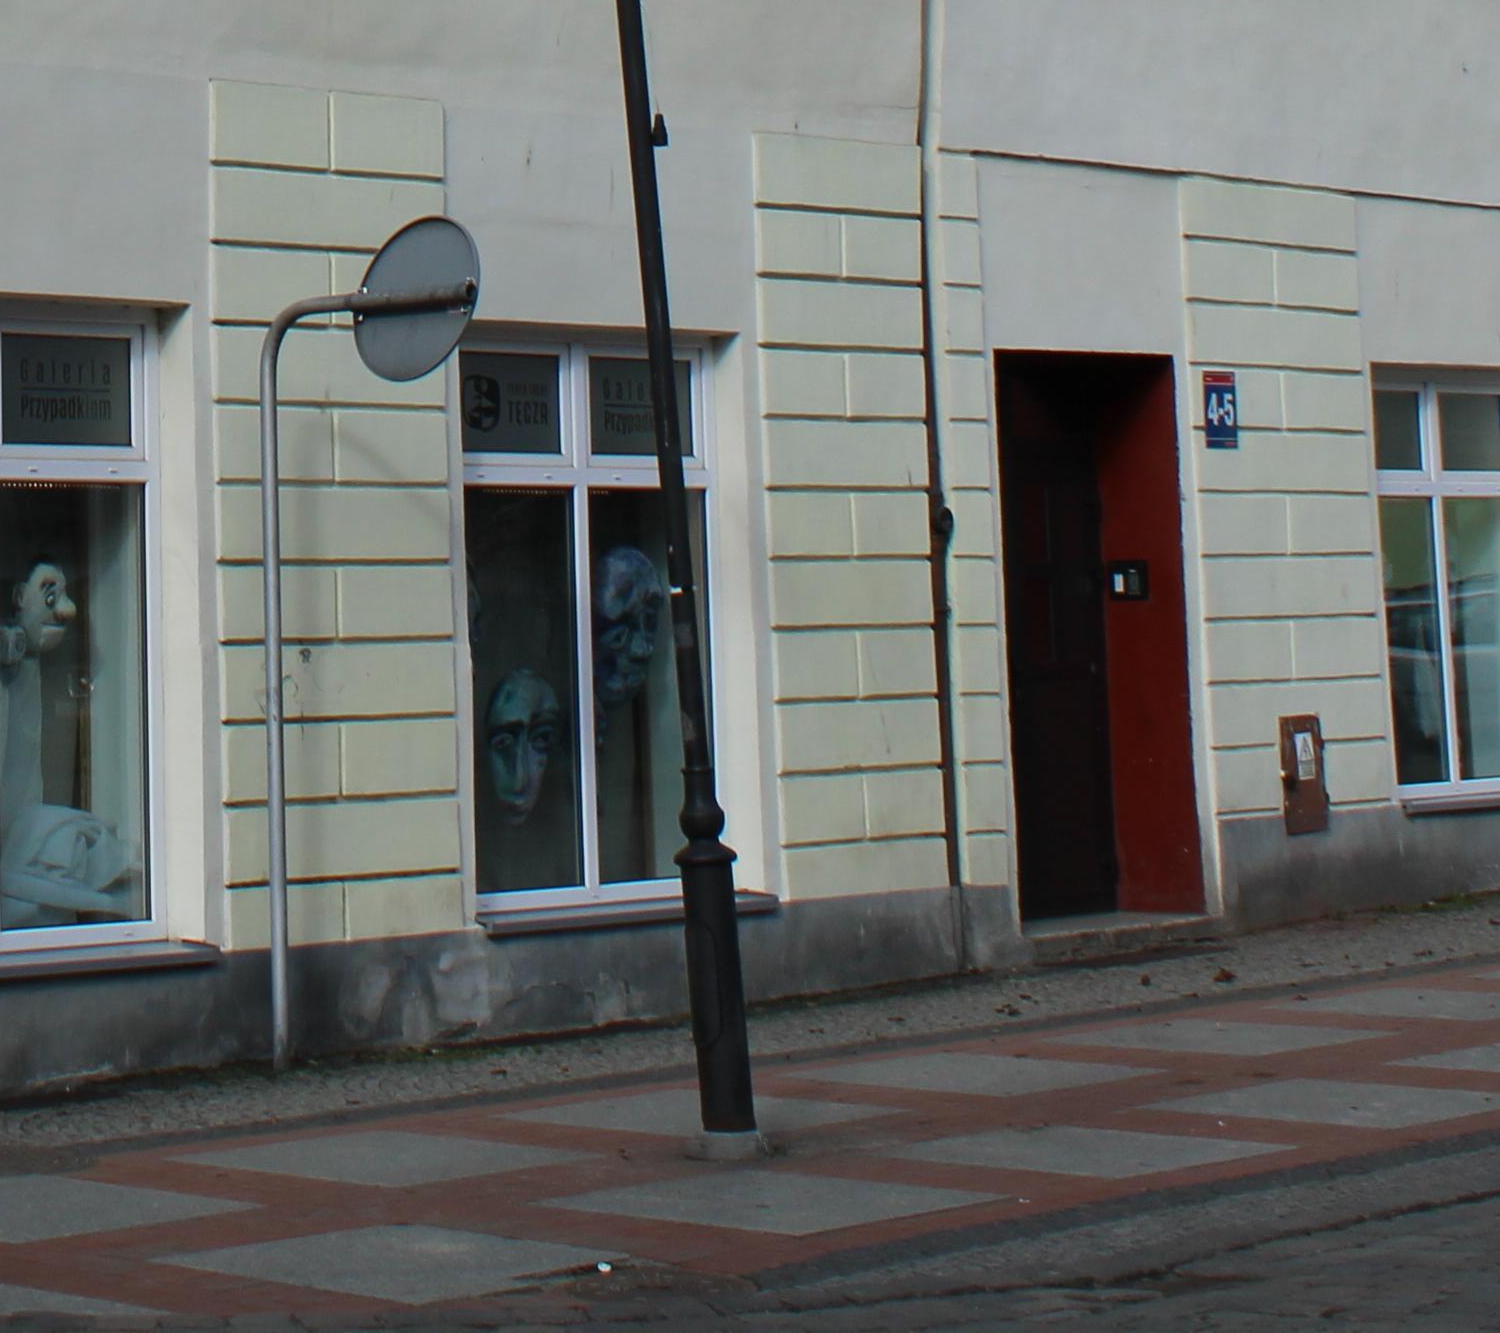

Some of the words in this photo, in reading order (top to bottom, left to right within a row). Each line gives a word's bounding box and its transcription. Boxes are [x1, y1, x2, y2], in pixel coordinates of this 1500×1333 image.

[19, 356, 112, 386] Galeria
[20, 393, 112, 424] Przypadkiem
[1207, 392, 1235, 427] 4-5
